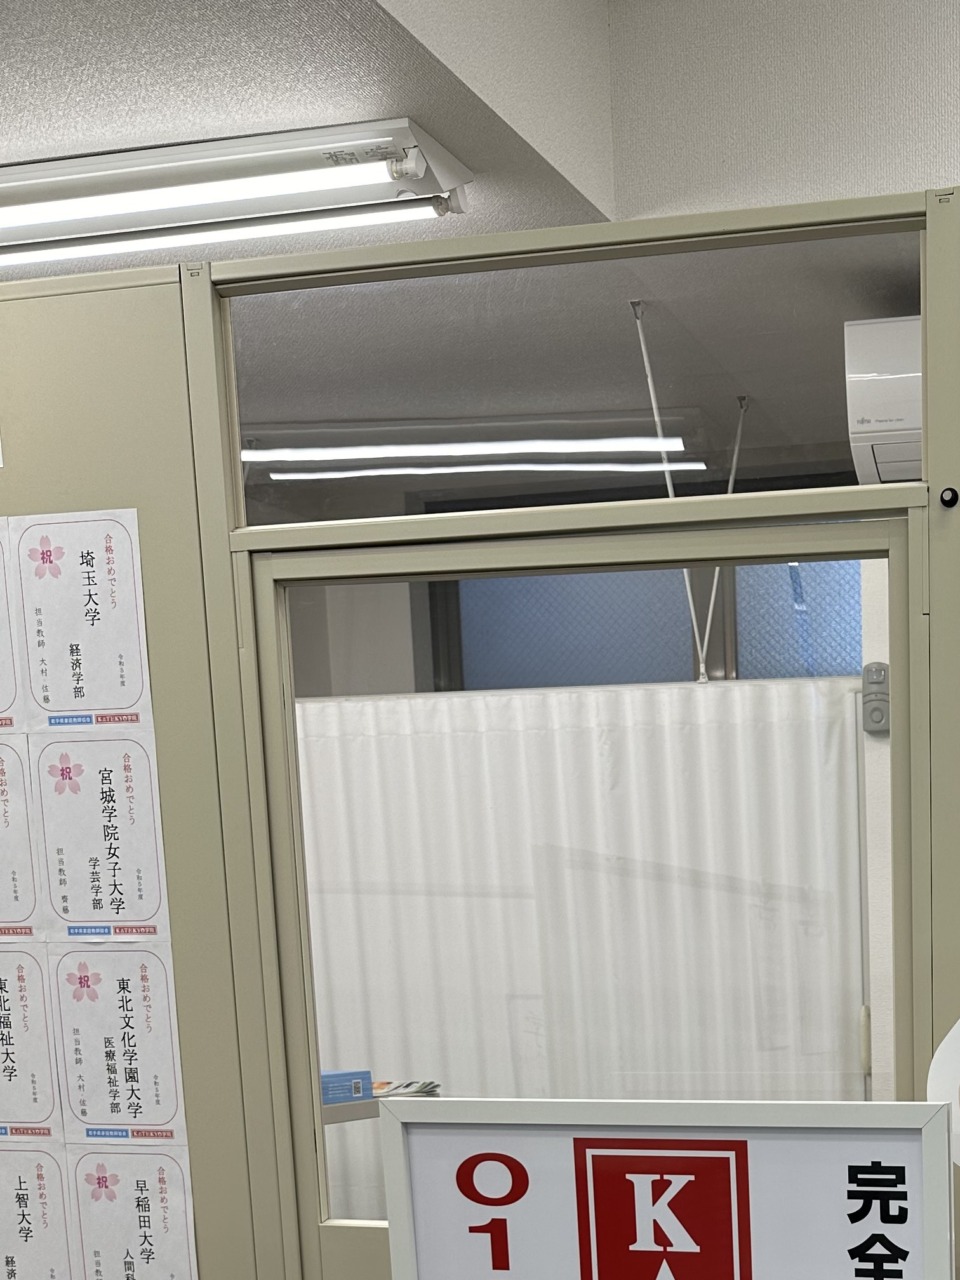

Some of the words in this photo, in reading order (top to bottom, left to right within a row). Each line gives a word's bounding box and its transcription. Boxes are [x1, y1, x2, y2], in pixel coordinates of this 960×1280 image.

[40, 550, 53, 564] 祝
[80, 550, 101, 626] 埼玉大学
[104, 534, 117, 609] 合格おめでとう
[69, 643, 85, 699] 経済学部
[60, 767, 72, 781] 祝
[123, 753, 135, 825] 合格おめでとう
[99, 768, 125, 914] 宮城学院女子大学
[89, 857, 103, 910] 学芸学部
[16, 964, 29, 1033] 合格おめでとう
[78, 975, 90, 988] 祝
[140, 964, 152, 1034] 合格おめでとう
[104, 1037, 121, 1114] 医療福祉学部
[116, 978, 143, 1119] 東北文化学園大学
[15, 1176, 33, 1242] 上智大学
[36, 1163, 48, 1229] 合格おめでとう
[96, 1176, 109, 1189] 祝
[157, 1167, 169, 1234] 合格おめでとう
[134, 1180, 155, 1264] 早稲田大学
